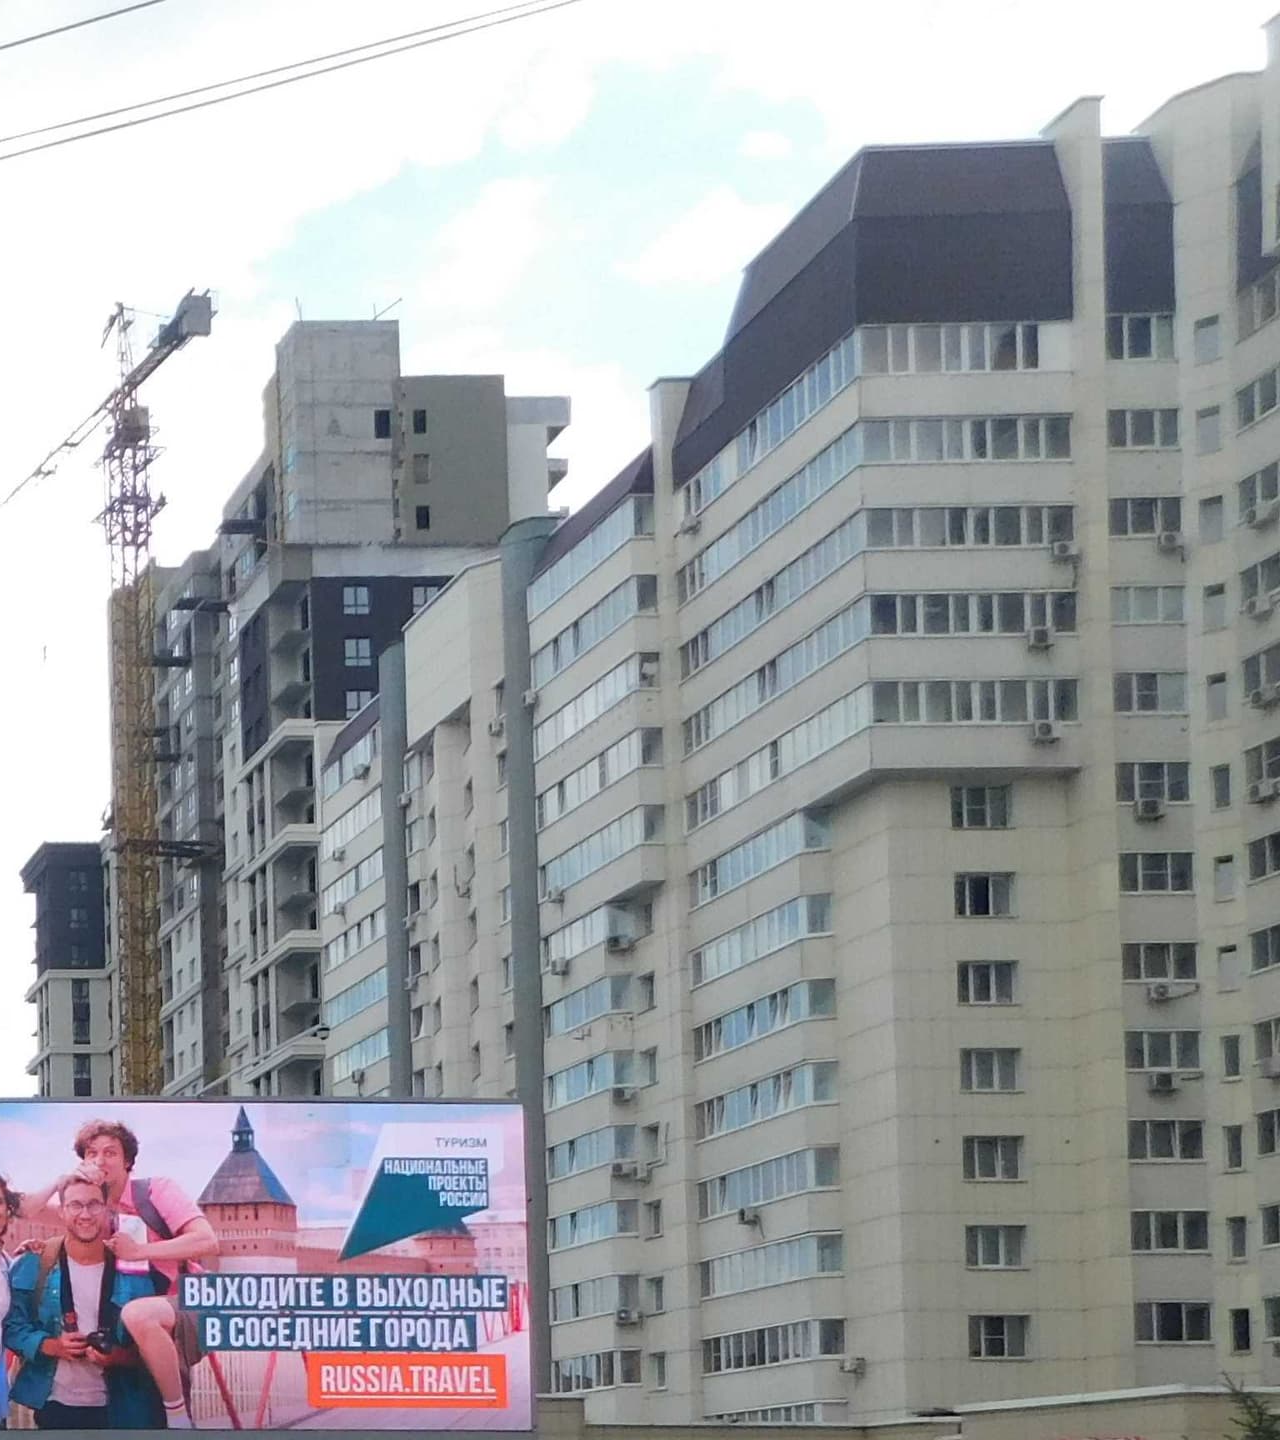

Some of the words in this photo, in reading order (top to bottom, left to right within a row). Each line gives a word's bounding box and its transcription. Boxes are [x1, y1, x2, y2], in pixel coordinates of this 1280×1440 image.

[435, 1137, 488, 1148] ТУРИЗМ
[383, 1159, 486, 1176] НАЦИОНАЛЬНЫЕ
[428, 1176, 487, 1190] ПРОЕКТЫ
[439, 1191, 488, 1206] РОССИИ
[184, 1276, 325, 1310] ВЫХОДИТЕ
[332, 1277, 348, 1306] В
[356, 1277, 506, 1310] ВЫХОДНЫЕ
[206, 1317, 222, 1347] В
[229, 1317, 362, 1350] СОСЕДНИЕ
[369, 1317, 470, 1351] ГОРОДА
[320, 1365, 497, 1393] RUSSIA.TRAVEL
